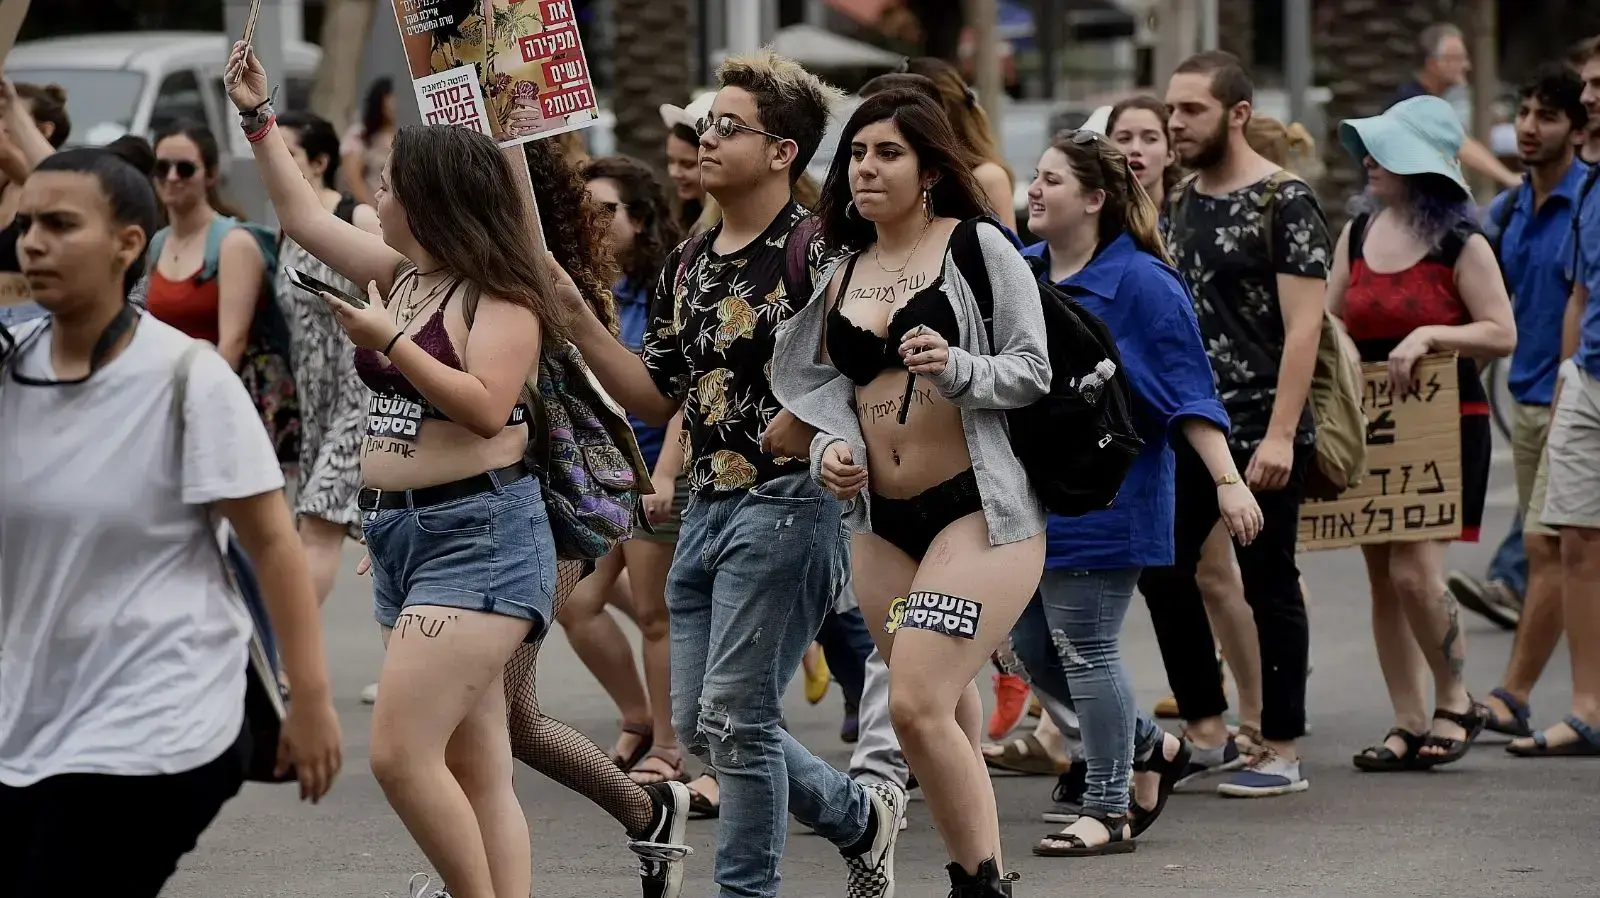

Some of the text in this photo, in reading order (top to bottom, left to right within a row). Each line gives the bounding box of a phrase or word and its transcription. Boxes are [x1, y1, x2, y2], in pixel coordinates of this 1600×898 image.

[404, 7, 439, 25] איילת שקד
[548, 1, 569, 21] את
[407, 14, 454, 35] שרת המשפטים
[524, 30, 576, 58] מפקירה
[549, 59, 584, 83] נשים
[425, 82, 475, 109] בסחר
[544, 88, 592, 116] בזנות?
[897, 272, 925, 294] שר
[369, 396, 422, 419] בועטו
[368, 415, 416, 436] בסקס
[384, 442, 416, 459] אחת
[1300, 499, 1456, 540] עם כל אחד
[906, 593, 978, 618] בועטות
